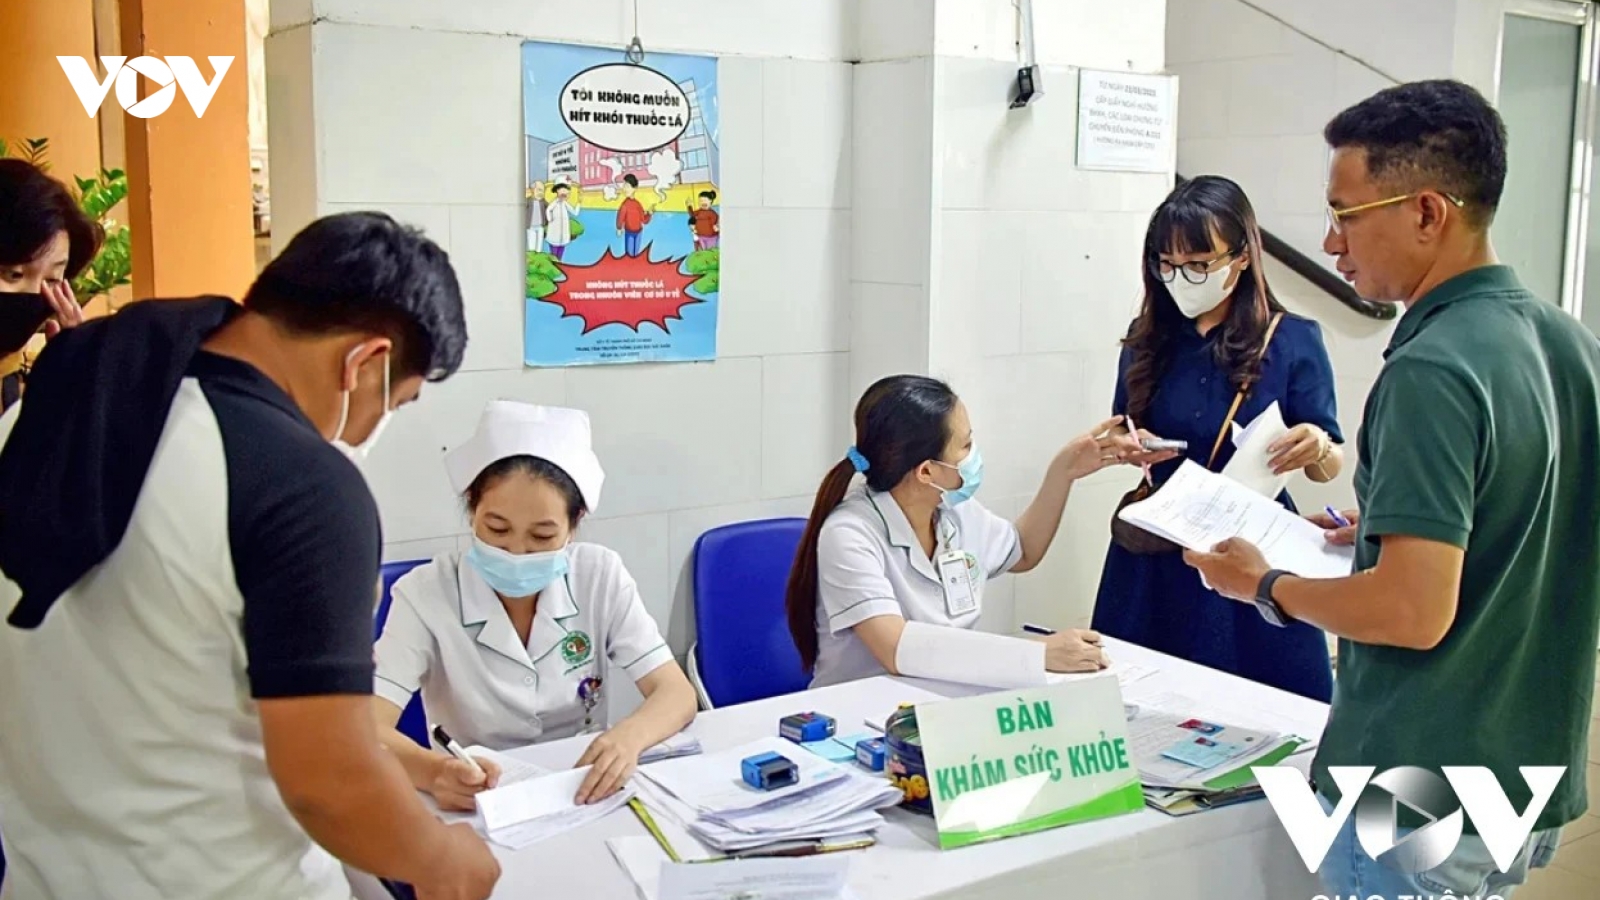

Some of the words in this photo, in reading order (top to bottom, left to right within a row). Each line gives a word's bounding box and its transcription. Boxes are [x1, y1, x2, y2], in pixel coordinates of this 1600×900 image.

[570, 87, 593, 101] TÔI
[597, 89, 641, 105] KHÔNG
[643, 89, 680, 107] MUỐN
[569, 107, 591, 122] HÍT
[593, 109, 623, 125] KHÓI
[625, 108, 667, 126] THUỐC
[668, 113, 683, 127] LÁ
[996, 697, 1053, 735] BÀN
[935, 754, 1007, 801] KHÁM
[1014, 744, 1062, 782] SỨC
[1067, 730, 1130, 778] KHỎE
